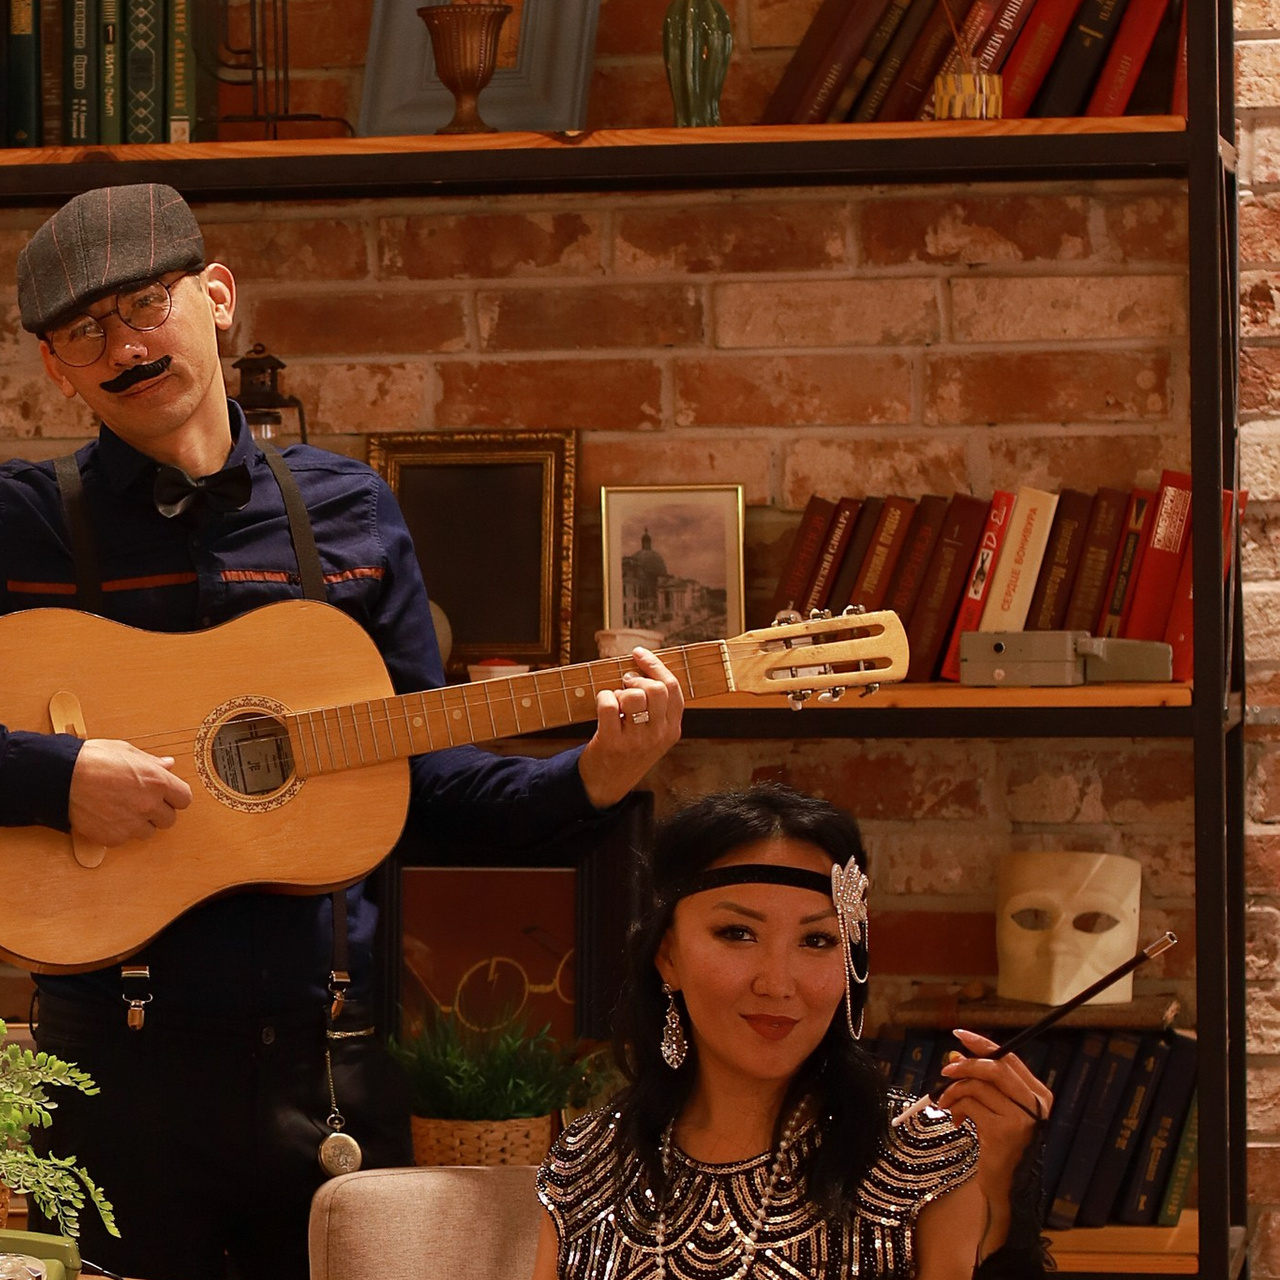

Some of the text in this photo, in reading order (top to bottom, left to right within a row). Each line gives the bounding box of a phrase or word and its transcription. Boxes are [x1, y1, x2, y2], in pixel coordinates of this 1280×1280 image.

[107, 25, 114, 42] 1
[73, 54, 88, 90] Право
[829, 510, 851, 554] СЛОВАРЬ
[880, 506, 902, 545] ПРОЦЕСС
[1000, 506, 1039, 612] СЕРДЦЕ БОНИВУРА
